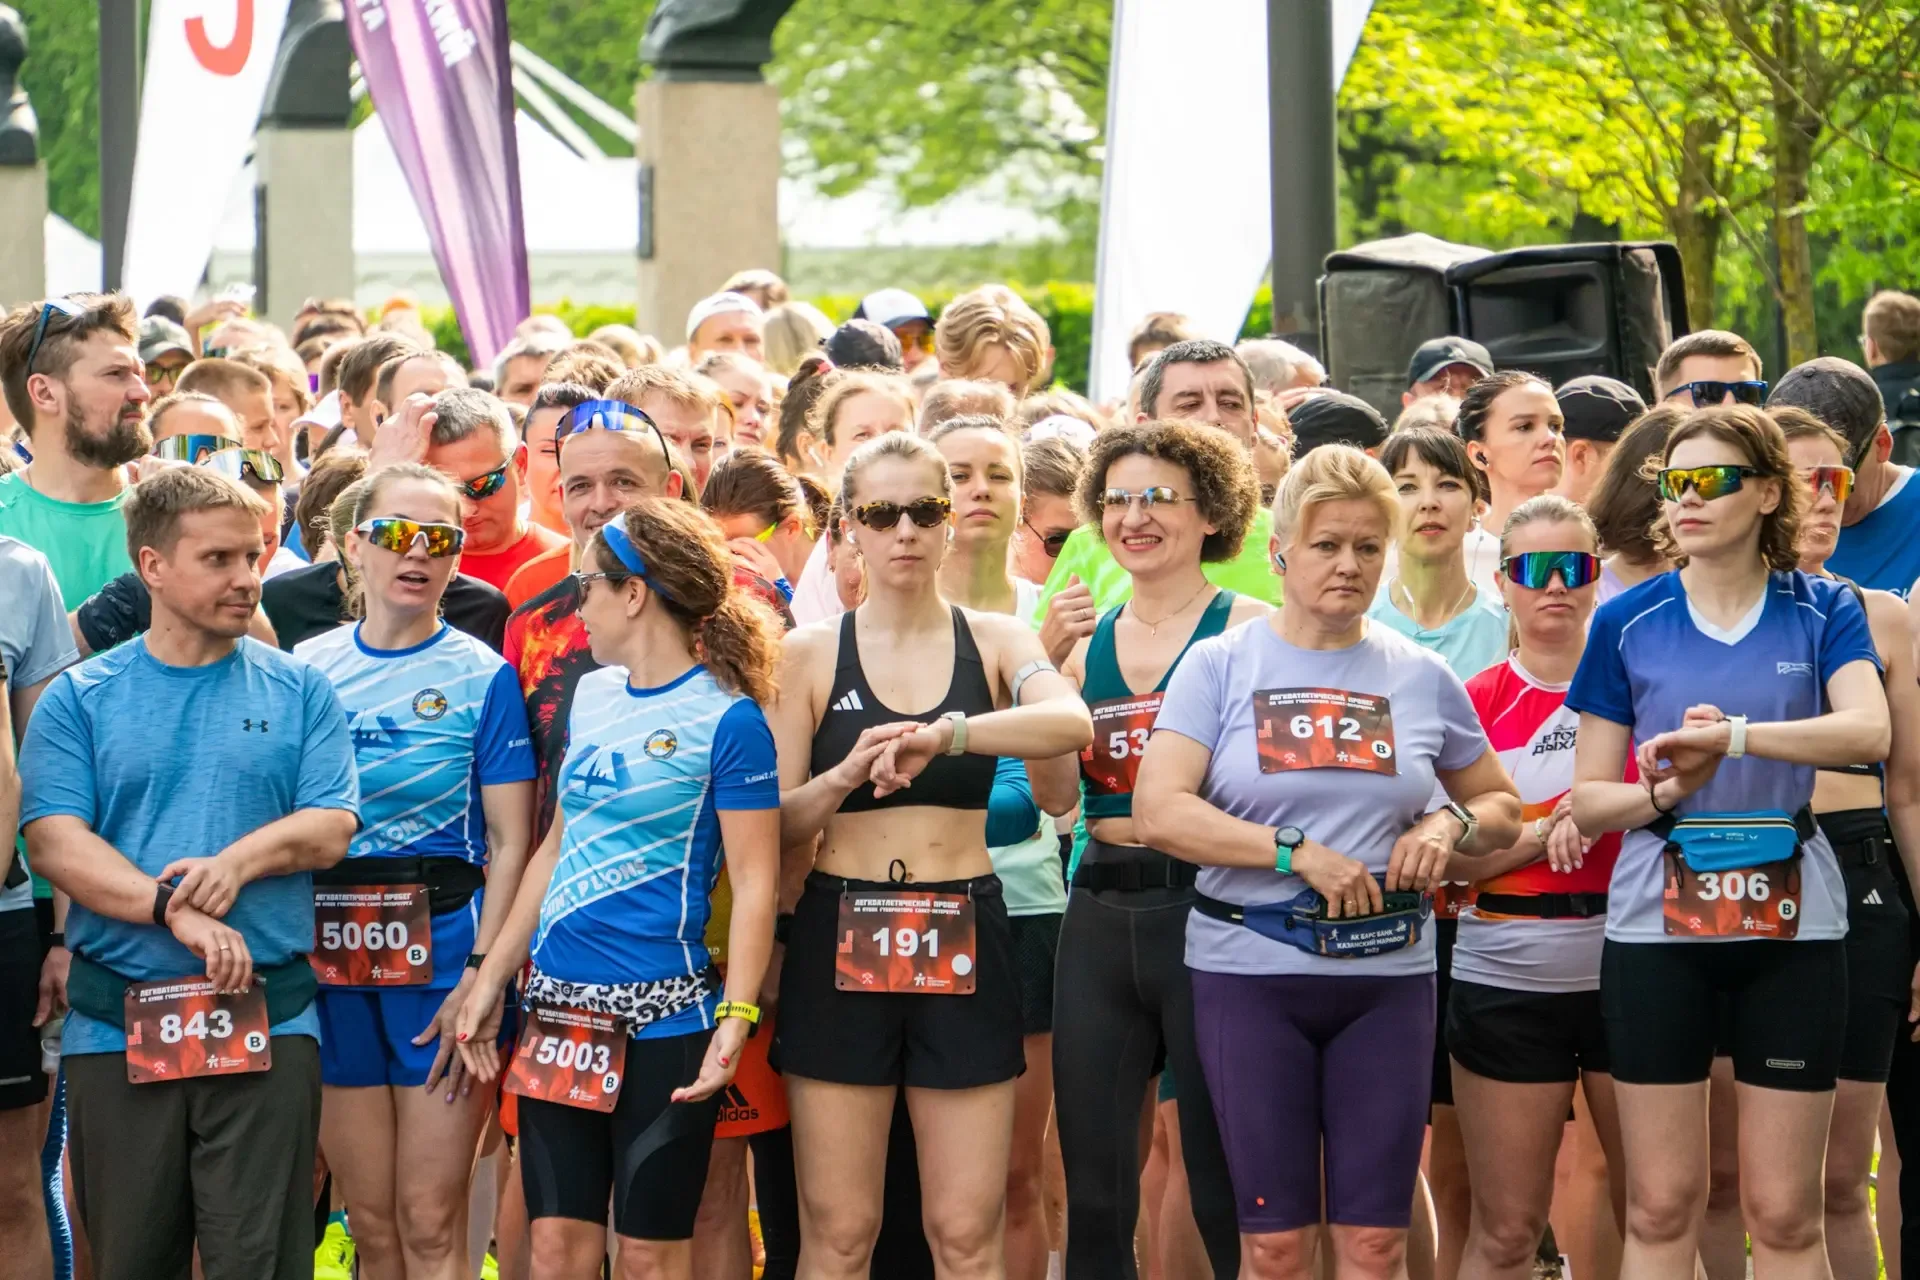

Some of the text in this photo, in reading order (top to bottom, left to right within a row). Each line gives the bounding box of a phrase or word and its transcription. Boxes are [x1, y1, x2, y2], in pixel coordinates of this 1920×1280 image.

[1268, 692, 1345, 702] ЛЕГКОАТЛЕТИЧЕСКИЙ
[1290, 715, 1363, 741] 612
[1697, 872, 1770, 902] 306
[854, 898, 960, 909] ЛЕГКОАТЛЕТИЧЕСКИЙ ПРОБЕГ
[322, 921, 408, 951] 5060
[872, 927, 938, 957] 191
[160, 1009, 233, 1043] 843
[536, 1036, 610, 1075] 5003
